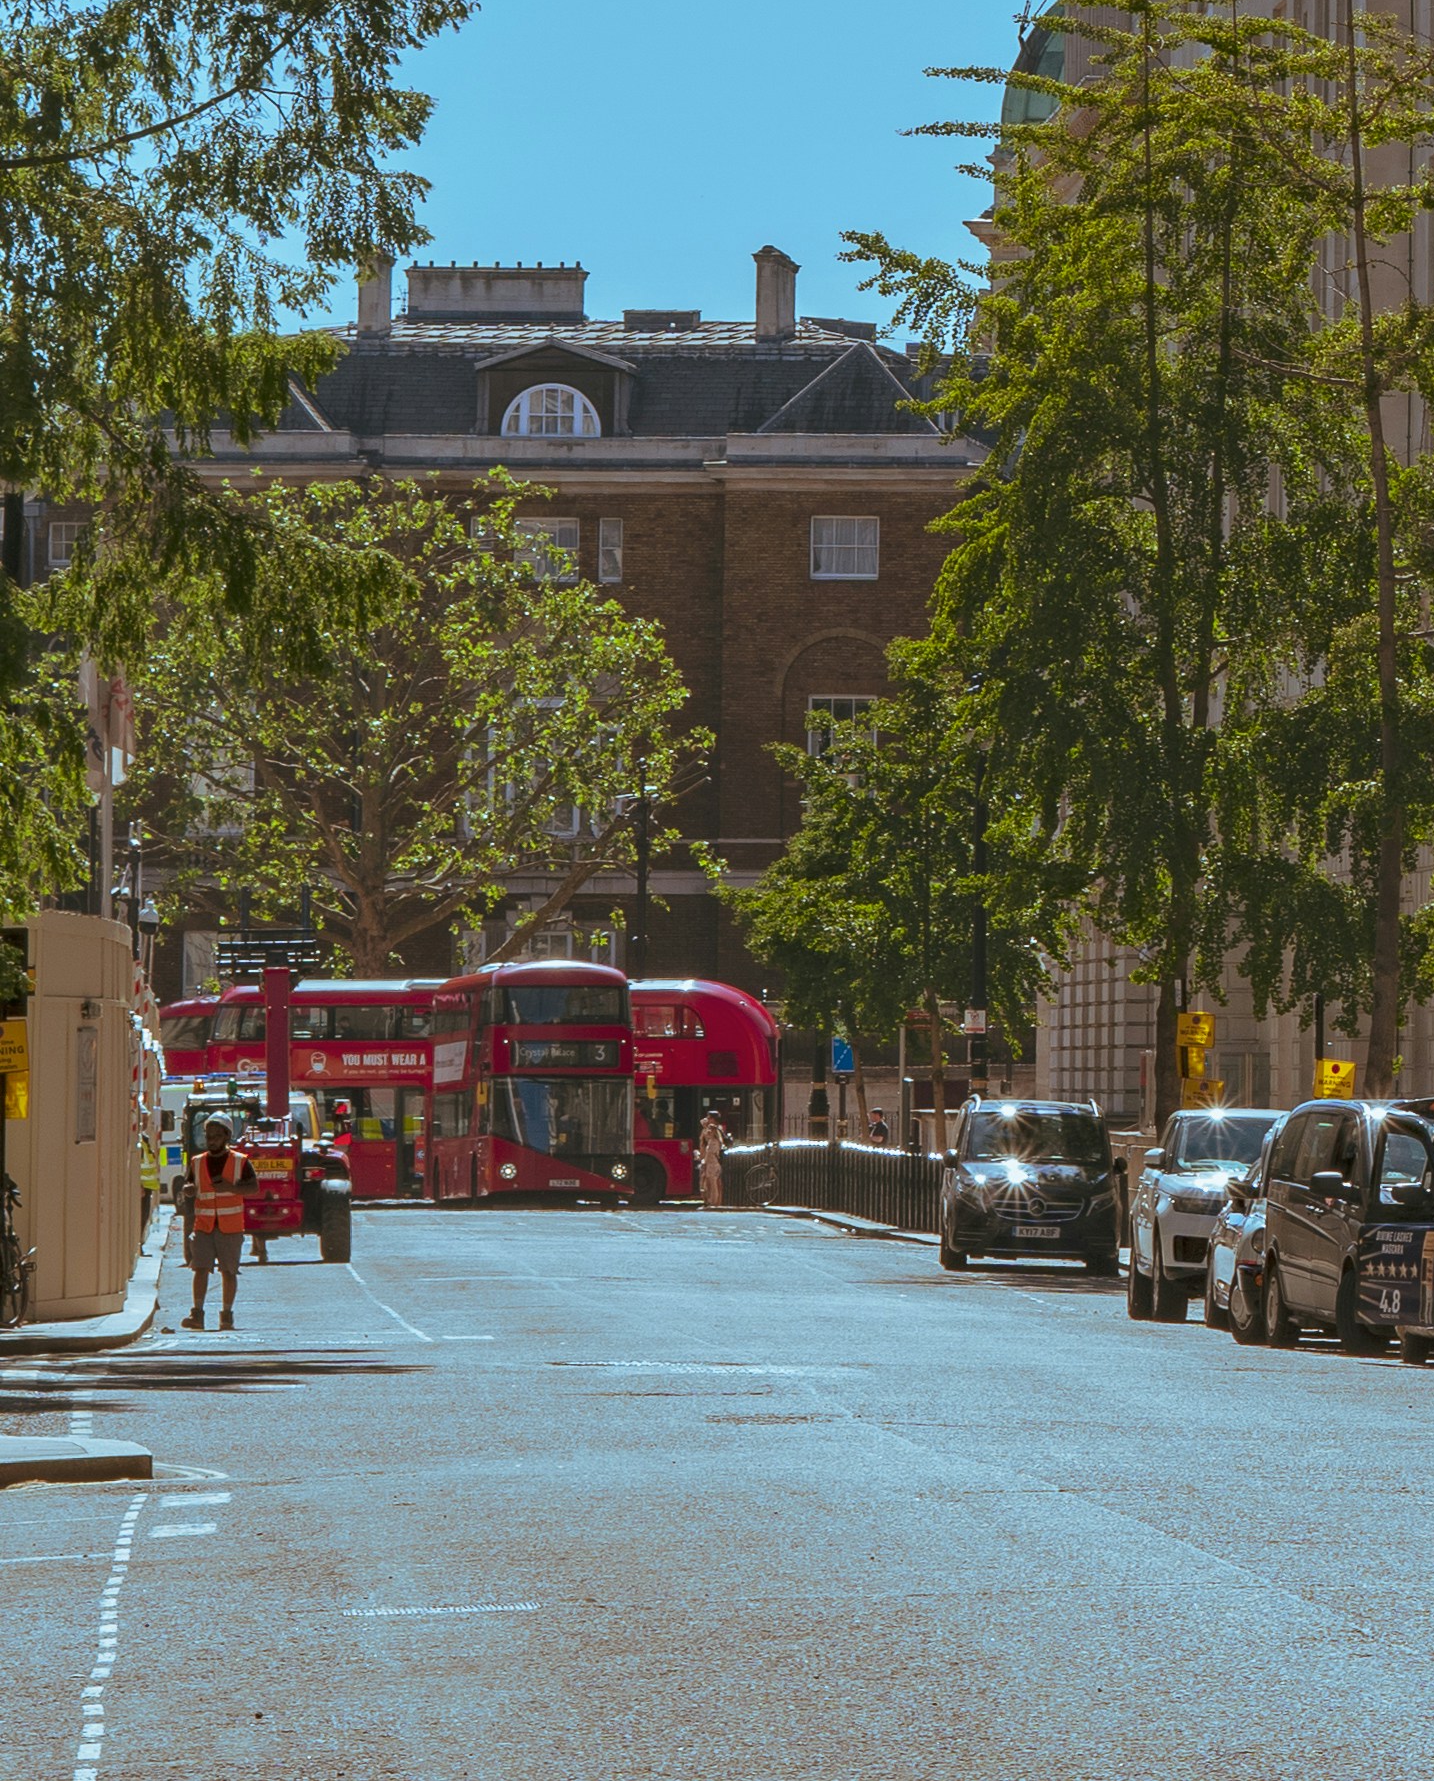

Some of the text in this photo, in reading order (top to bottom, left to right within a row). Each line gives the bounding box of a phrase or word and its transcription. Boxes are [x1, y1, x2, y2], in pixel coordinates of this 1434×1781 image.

[520, 1046, 550, 1059] Crystal
[594, 1045, 606, 1061] 3
[342, 1054, 360, 1066] YOU
[363, 1054, 388, 1066] MUST
[391, 1054, 416, 1066] WEAR
[419, 1054, 426, 1066] A
[1380, 1289, 1400, 1313] 4.8
